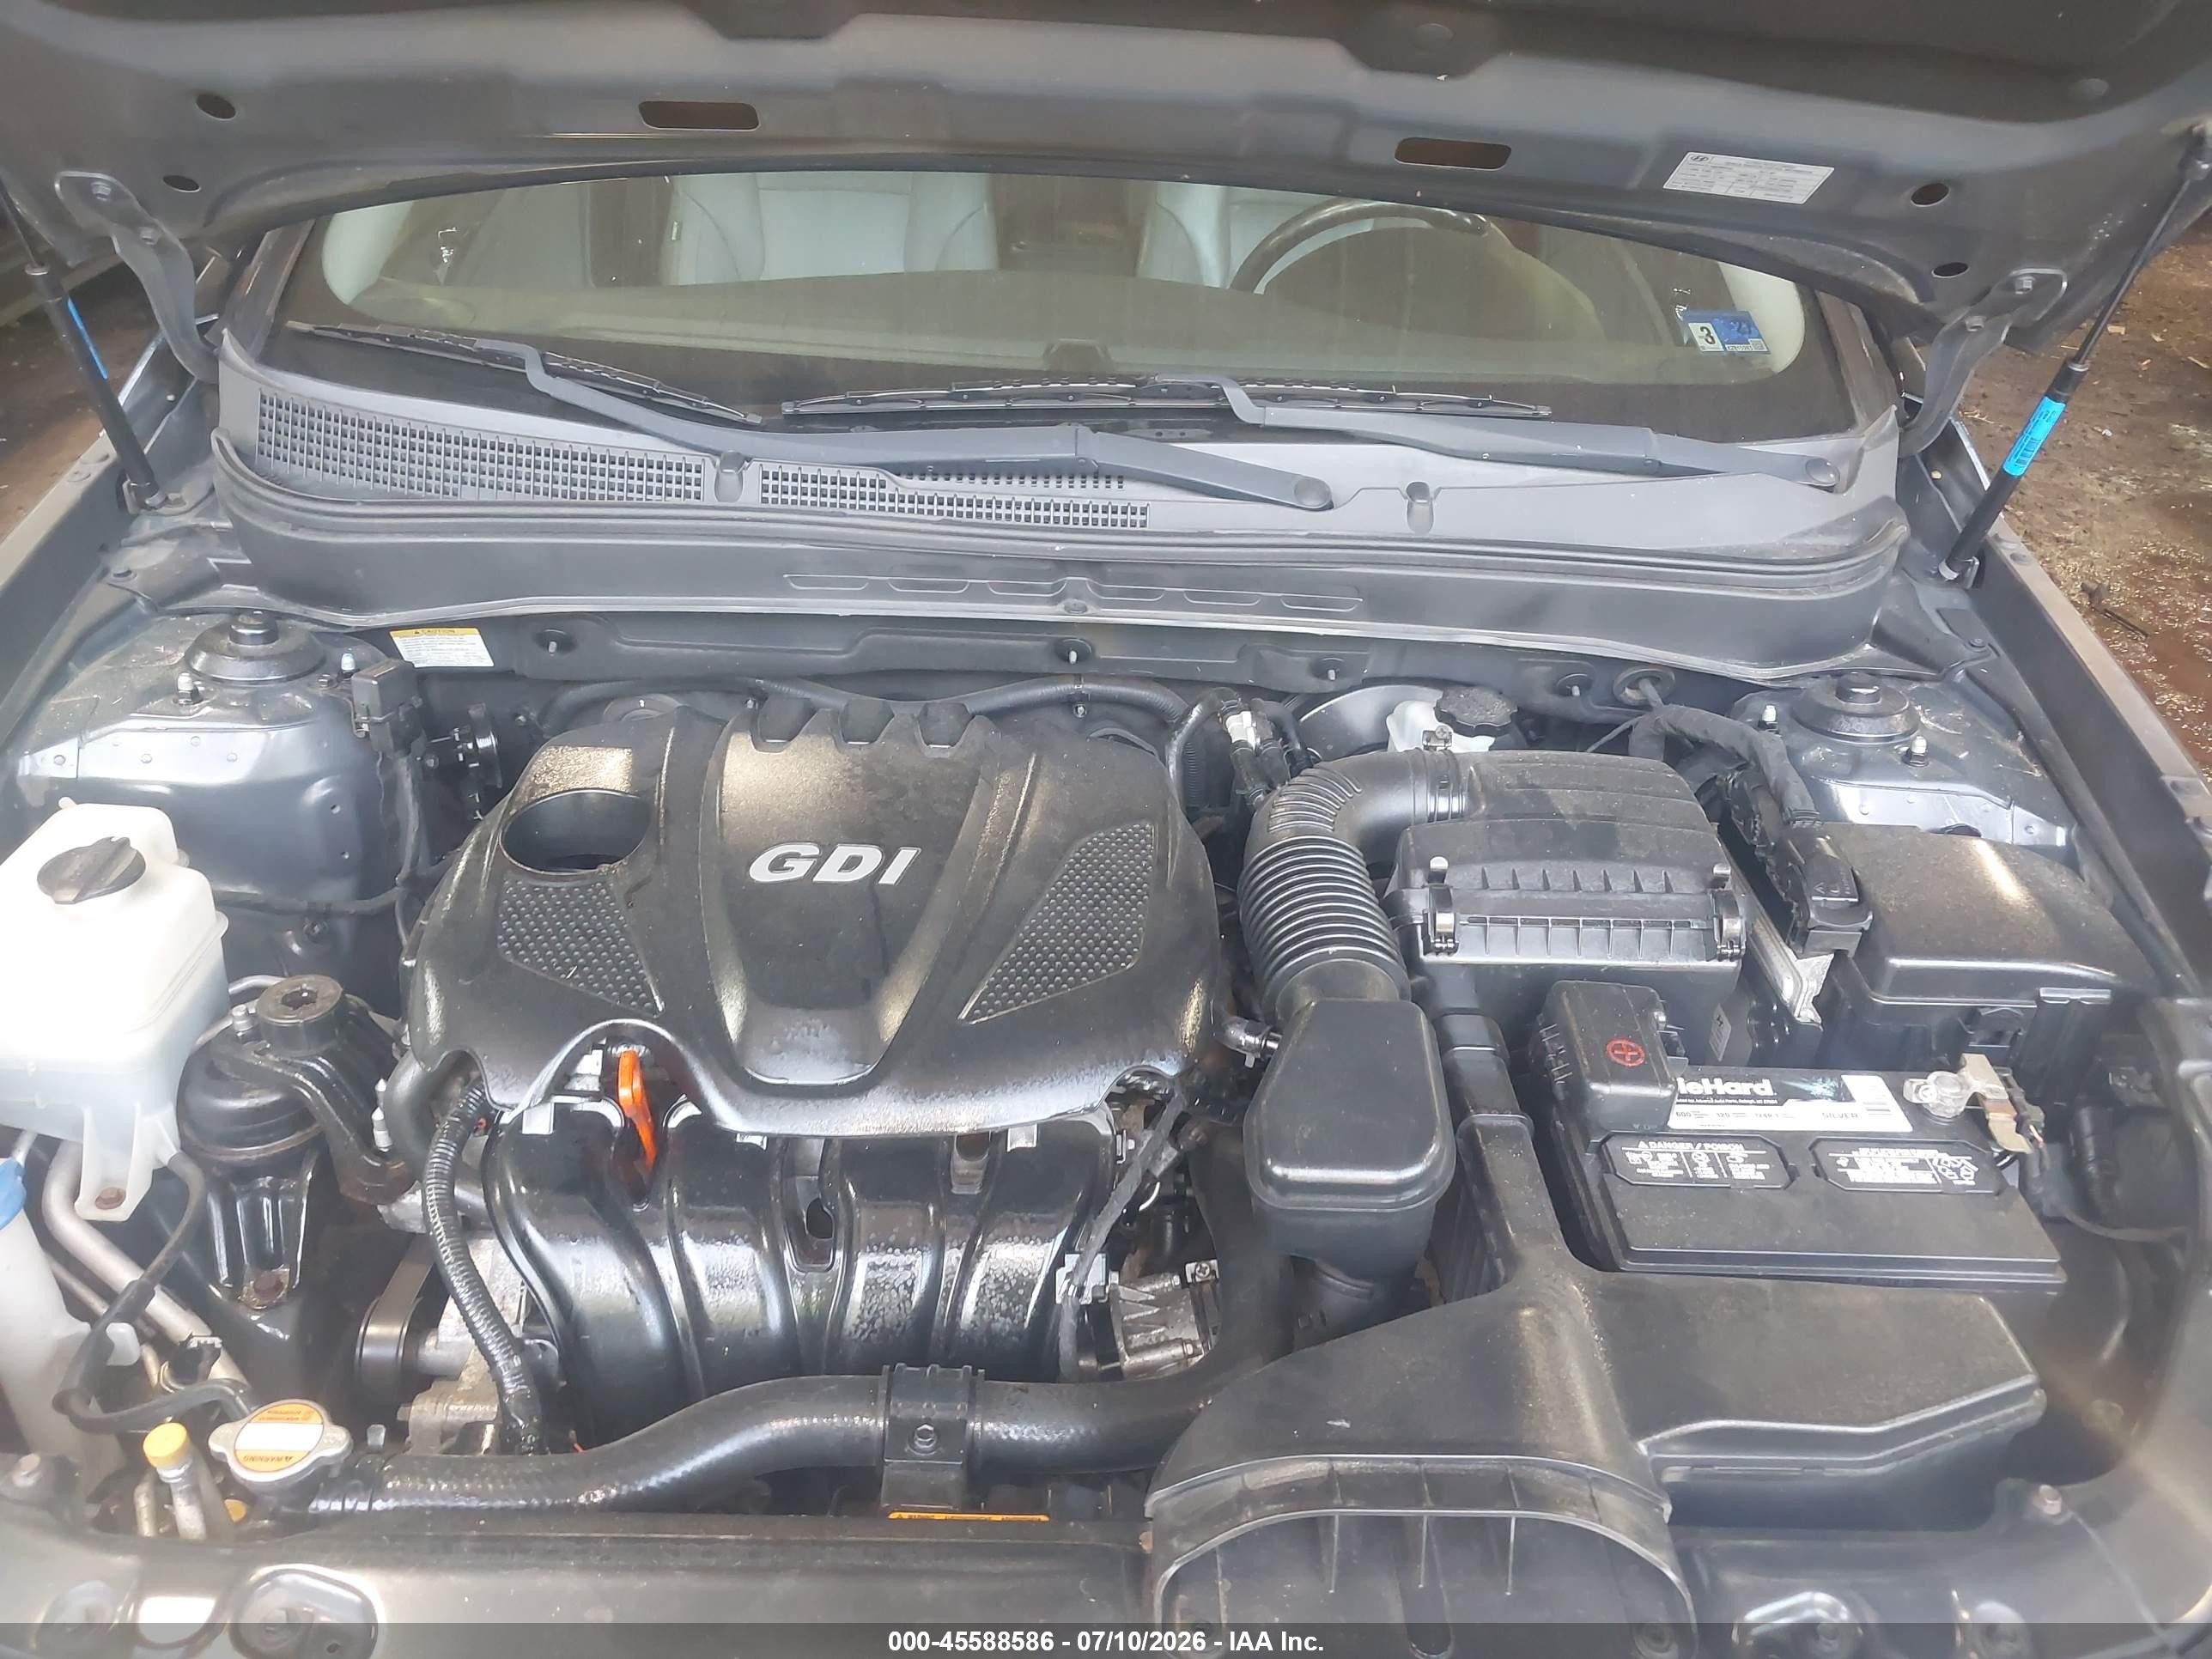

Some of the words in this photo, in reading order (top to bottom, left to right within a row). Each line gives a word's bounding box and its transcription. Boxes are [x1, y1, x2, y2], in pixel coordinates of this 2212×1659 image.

[1699, 326, 1716, 345] 3
[749, 842, 922, 885] GDI
[1676, 1077, 1774, 1097] ieHard
[1648, 1141, 1694, 1150] DANGER
